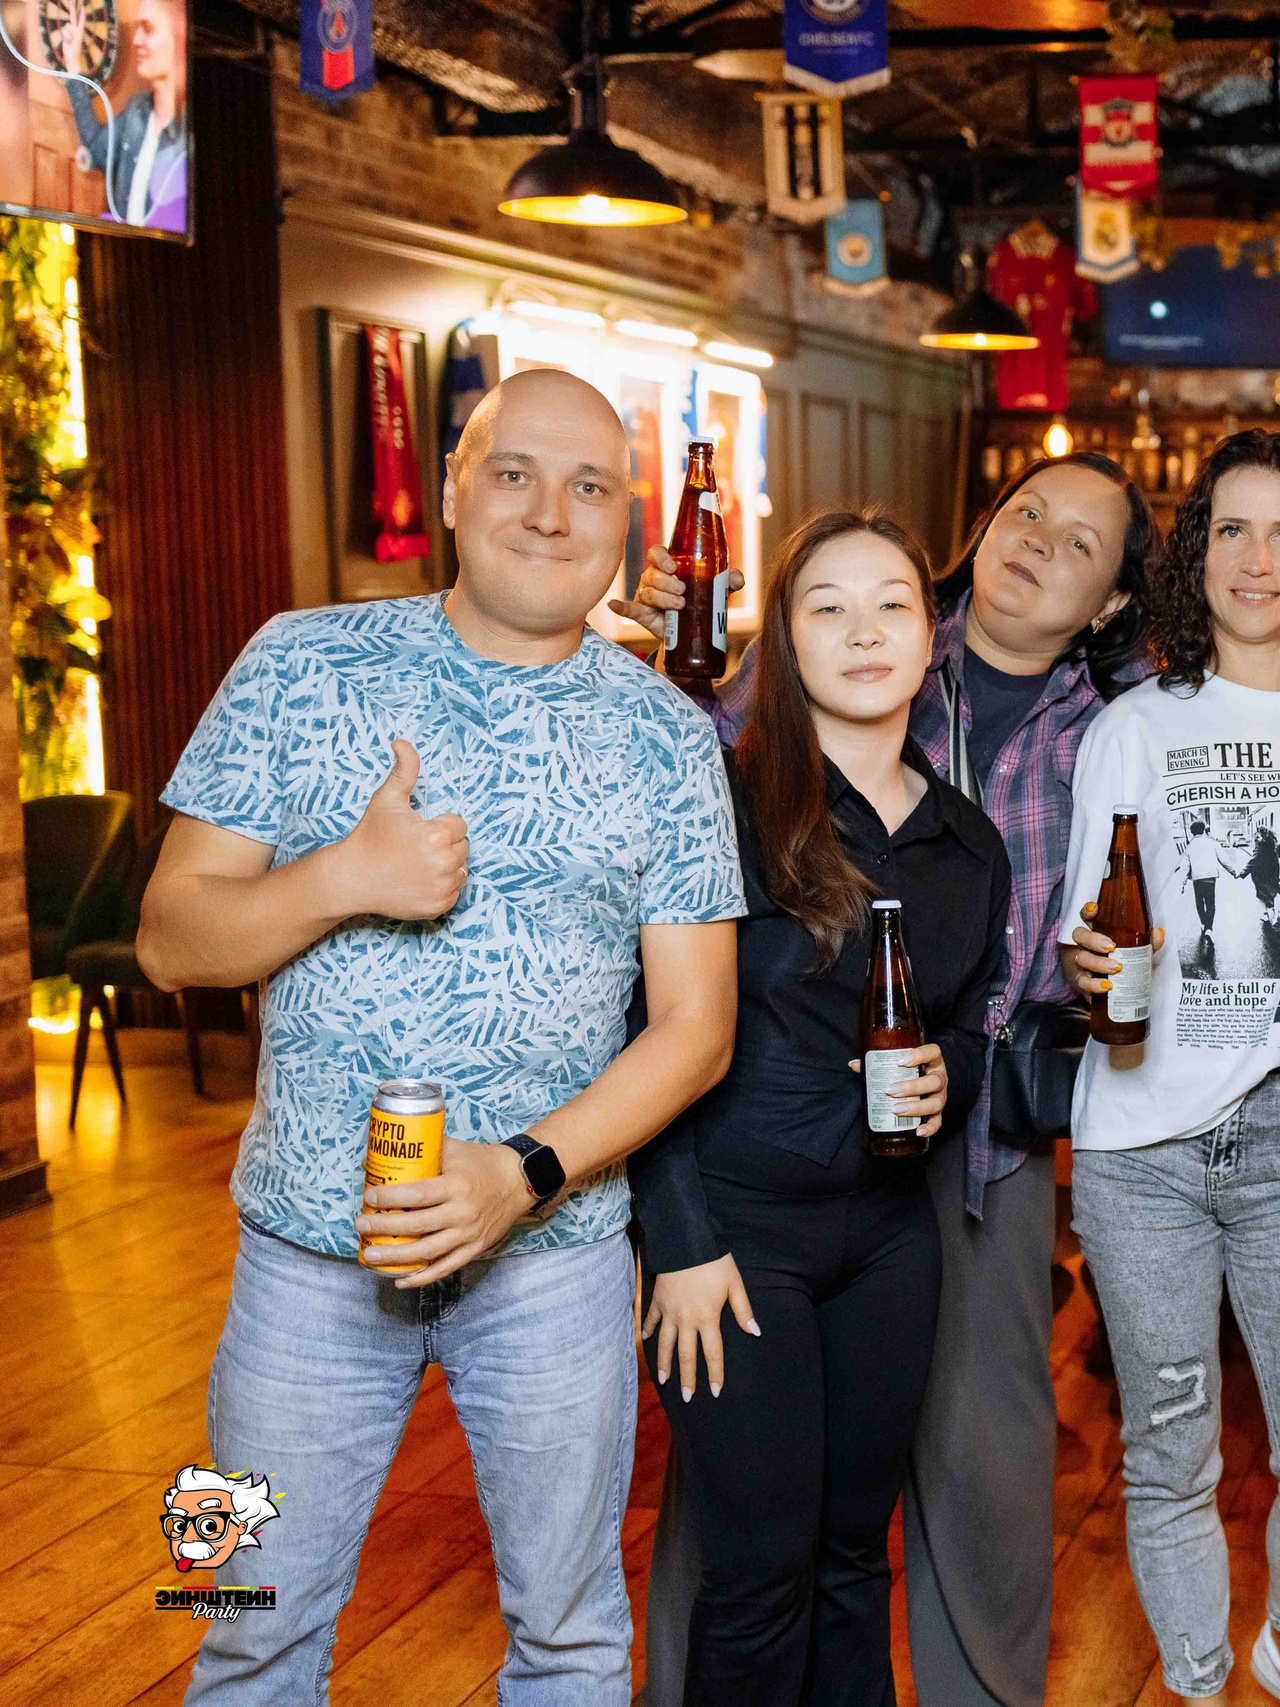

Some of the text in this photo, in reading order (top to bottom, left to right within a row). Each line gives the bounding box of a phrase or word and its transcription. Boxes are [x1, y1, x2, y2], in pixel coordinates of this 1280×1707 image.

[1169, 748, 1207, 760] MARCH IS
[1214, 743, 1273, 768] THE
[1169, 758, 1204, 769] EVENING
[1220, 773, 1246, 781] LET'S
[1248, 773, 1265, 781] SEE
[1166, 786, 1236, 805] CHERISH
[1240, 787, 1251, 799] A
[1182, 982, 1277, 996] My life is full of
[1179, 994, 1267, 1010] love and hope
